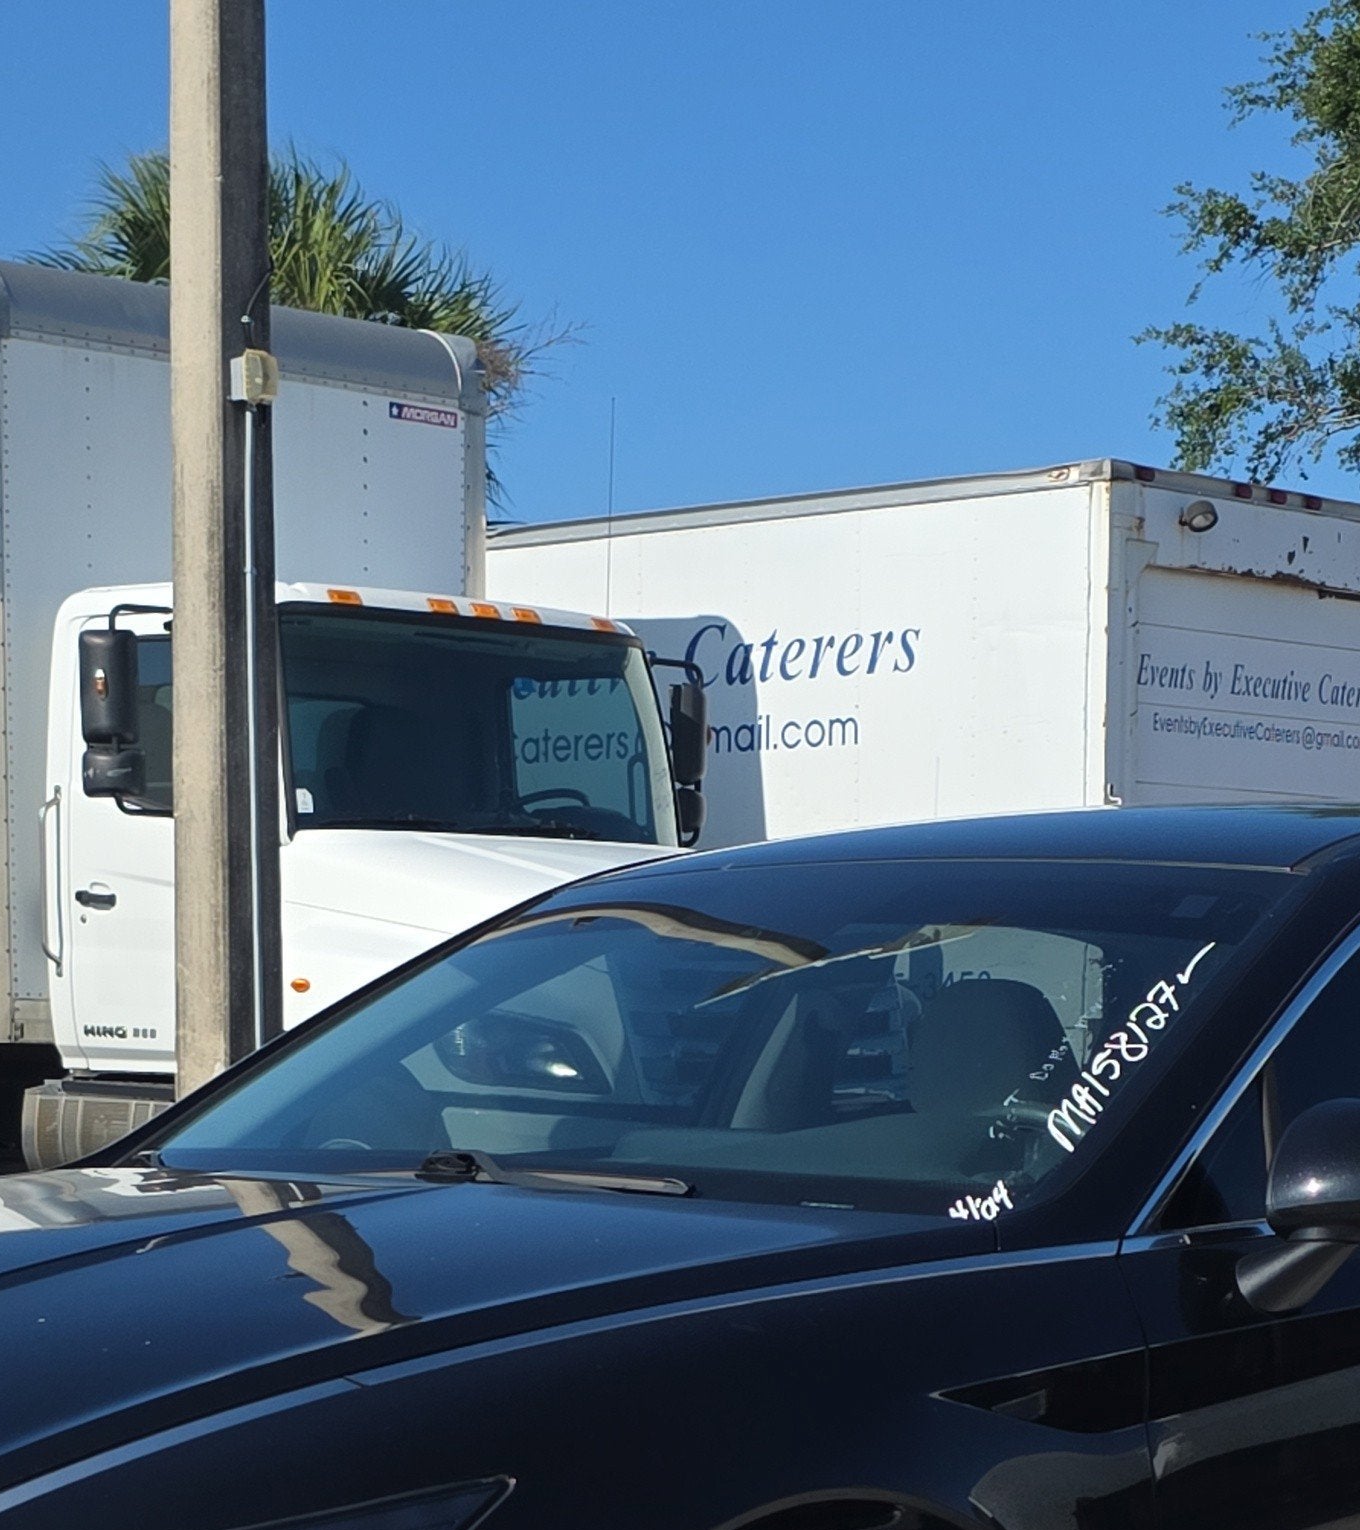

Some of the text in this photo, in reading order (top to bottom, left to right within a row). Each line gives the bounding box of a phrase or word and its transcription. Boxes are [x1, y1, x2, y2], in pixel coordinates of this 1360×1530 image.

[401, 406, 456, 426] MORGAN
[684, 623, 921, 689] Caterers
[1137, 653, 1196, 691] Events
[1202, 660, 1223, 699] by
[1230, 663, 1312, 703] Executive
